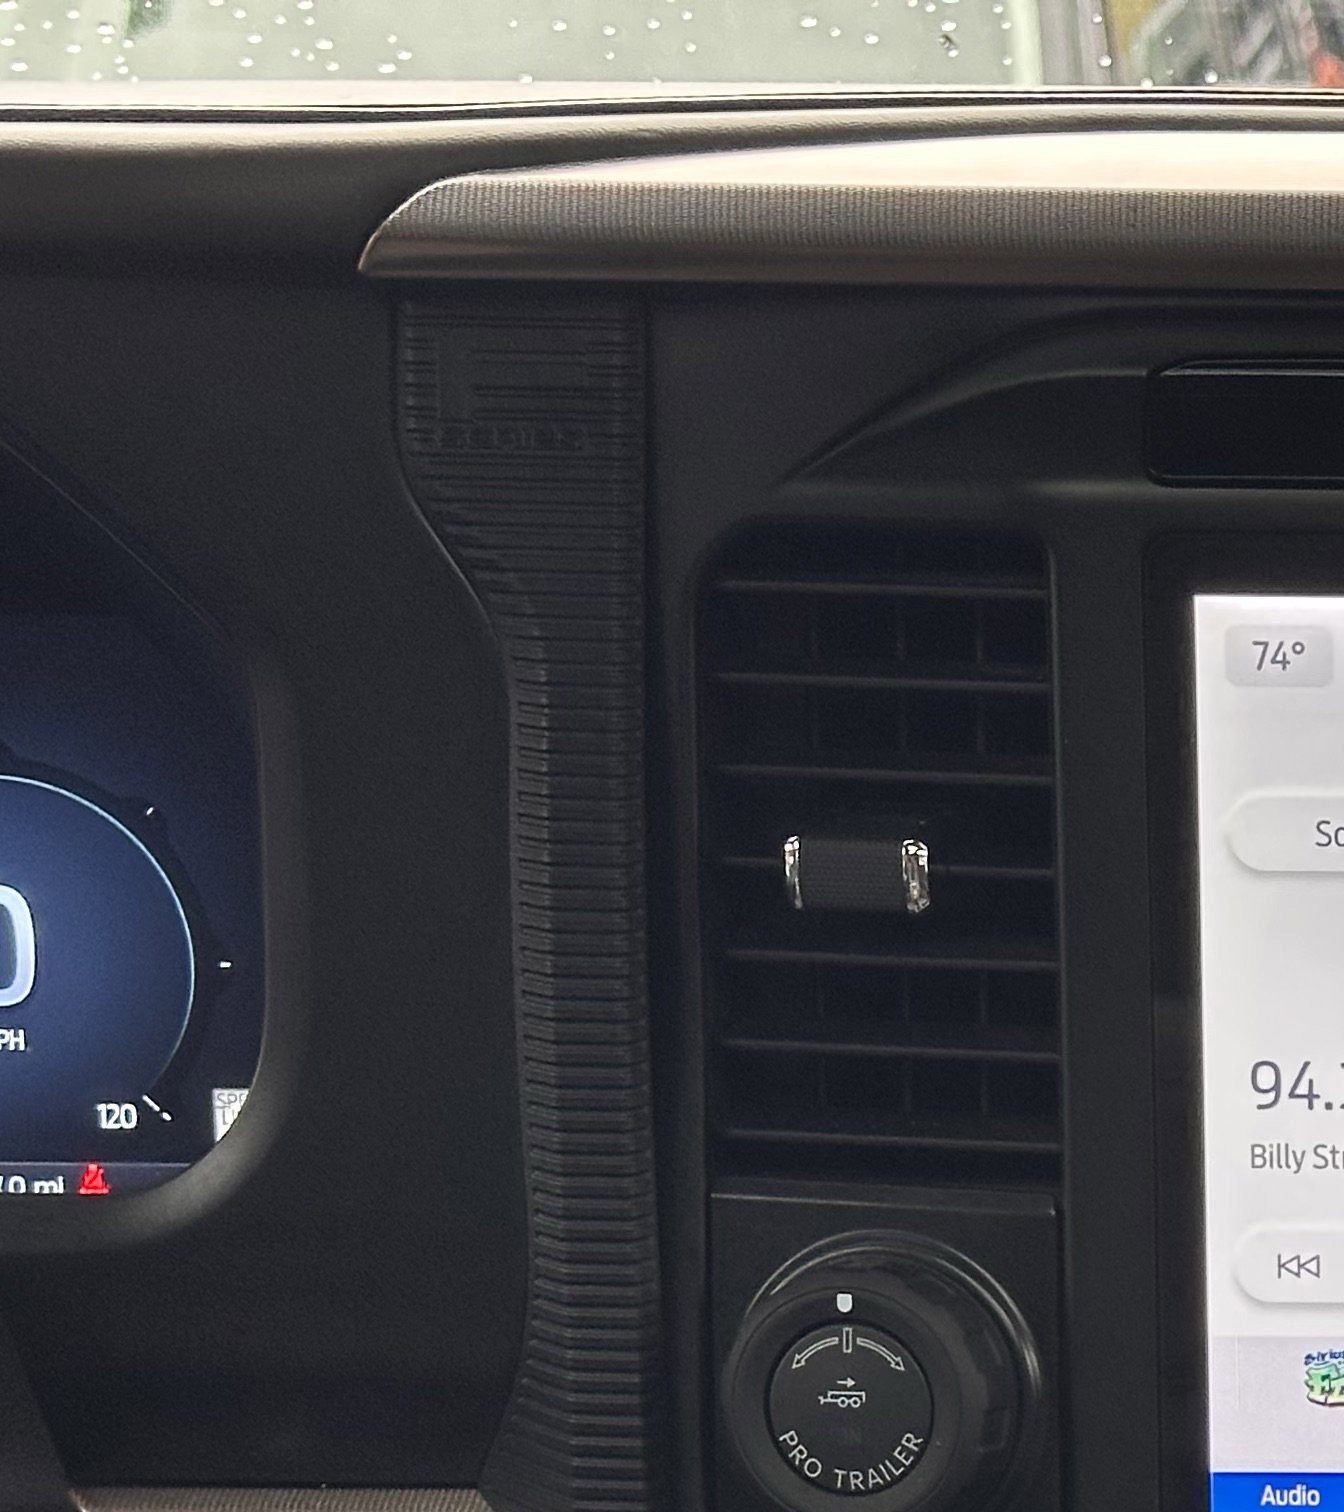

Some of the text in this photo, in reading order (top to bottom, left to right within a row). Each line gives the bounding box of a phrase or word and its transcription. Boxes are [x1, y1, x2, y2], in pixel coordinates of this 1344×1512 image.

[1252, 640, 1306, 672] 74°
[97, 1103, 138, 1129] 120
[1250, 1142, 1307, 1175] Billy
[779, 1430, 924, 1490] PRO TRAILER
[1260, 1484, 1320, 1506] Audio
